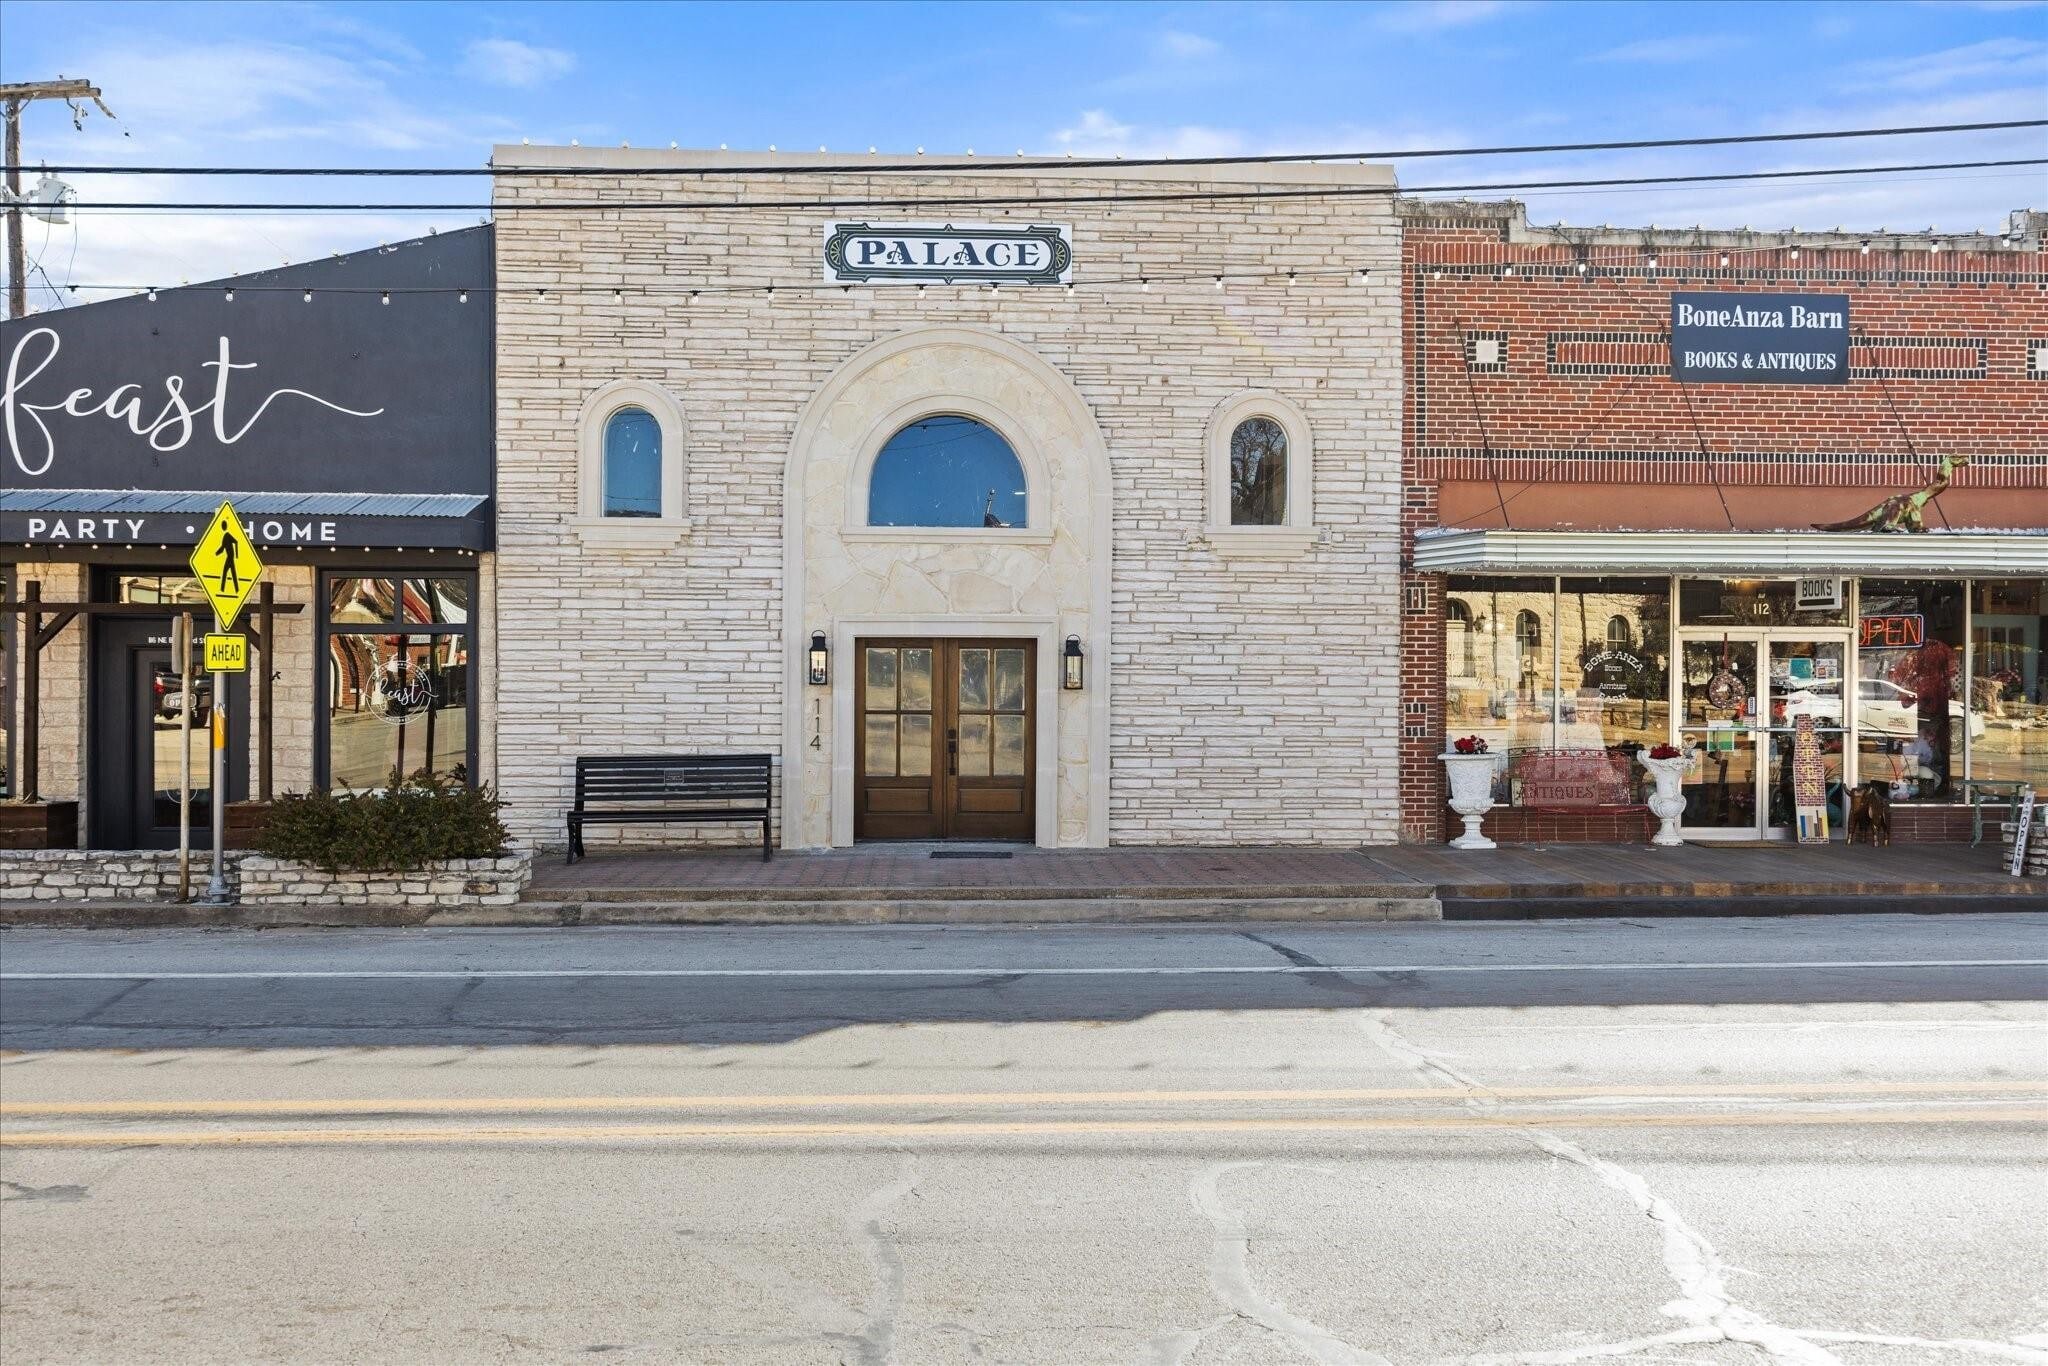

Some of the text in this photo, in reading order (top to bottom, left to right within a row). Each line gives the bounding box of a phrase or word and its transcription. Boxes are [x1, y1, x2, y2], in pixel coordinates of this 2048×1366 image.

[857, 240, 1040, 267] PALACE
[1678, 304, 1844, 329] BoneAnza Barn
[1684, 351, 1837, 372] BOOKS & ANTIQUES
[0, 327, 384, 476] feast
[28, 518, 145, 540] PARTY
[1802, 579, 1833, 598] BOOKS
[1753, 603, 1769, 615] 112
[211, 644, 241, 661] AHEAD
[810, 698, 821, 751] 114
[2013, 816, 2028, 870] OPEN
